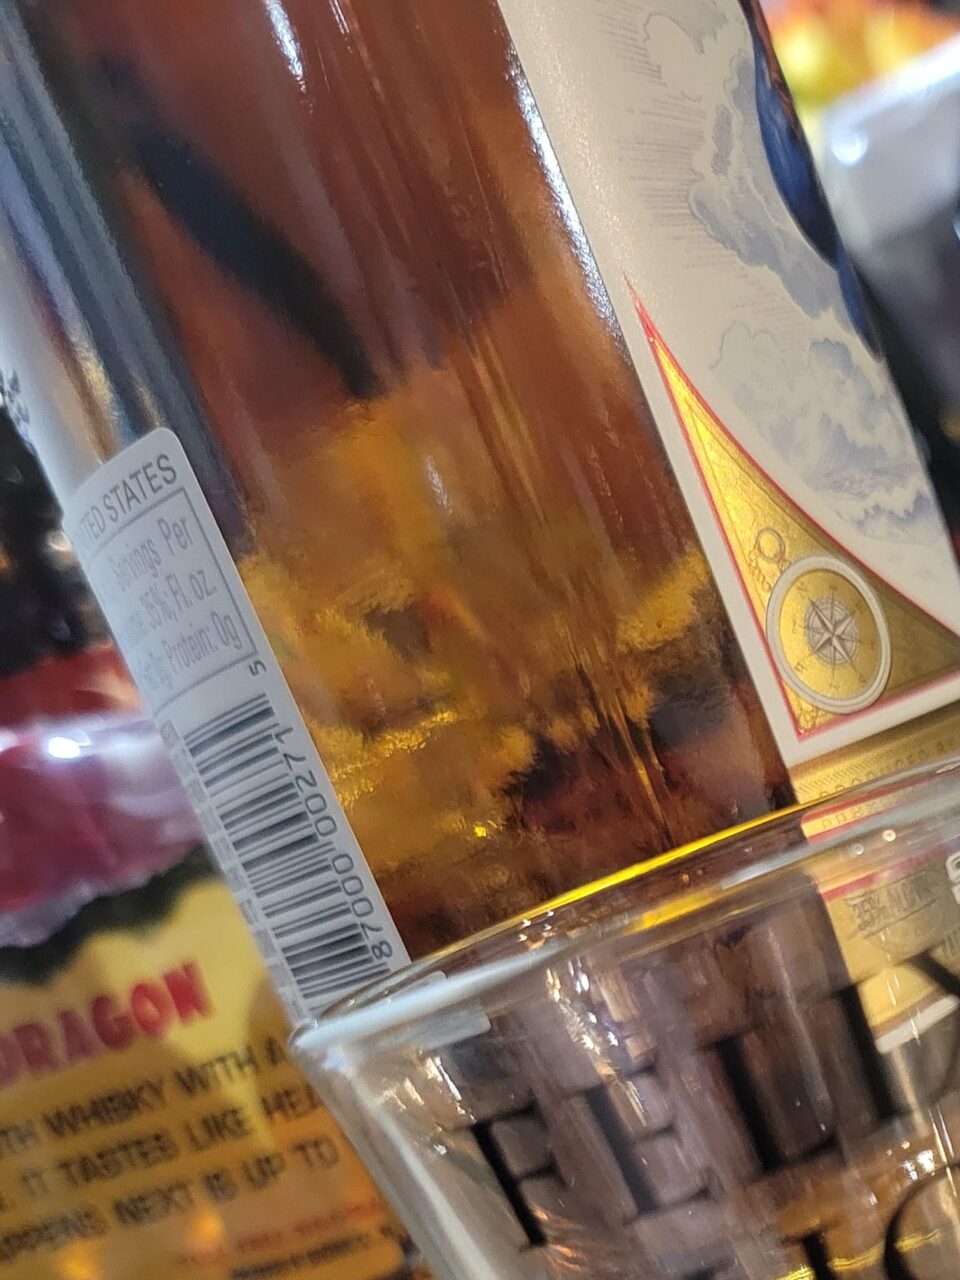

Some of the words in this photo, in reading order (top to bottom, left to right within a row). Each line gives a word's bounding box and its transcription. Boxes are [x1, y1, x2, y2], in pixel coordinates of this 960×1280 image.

[104, 453, 178, 523] STATES
[158, 517, 194, 558] Per
[191, 569, 217, 601] oz.
[162, 622, 218, 674] Protein:
[249, 659, 268, 677] 5
[274, 727, 338, 838] 00271
[174, 1046, 259, 1096] WITH
[58, 1129, 180, 1187] TASTES
[185, 1108, 254, 1152] LIKE
[113, 1180, 195, 1226] NEXT
[242, 1152, 287, 1192] UP
[293, 1135, 341, 1170] TO
